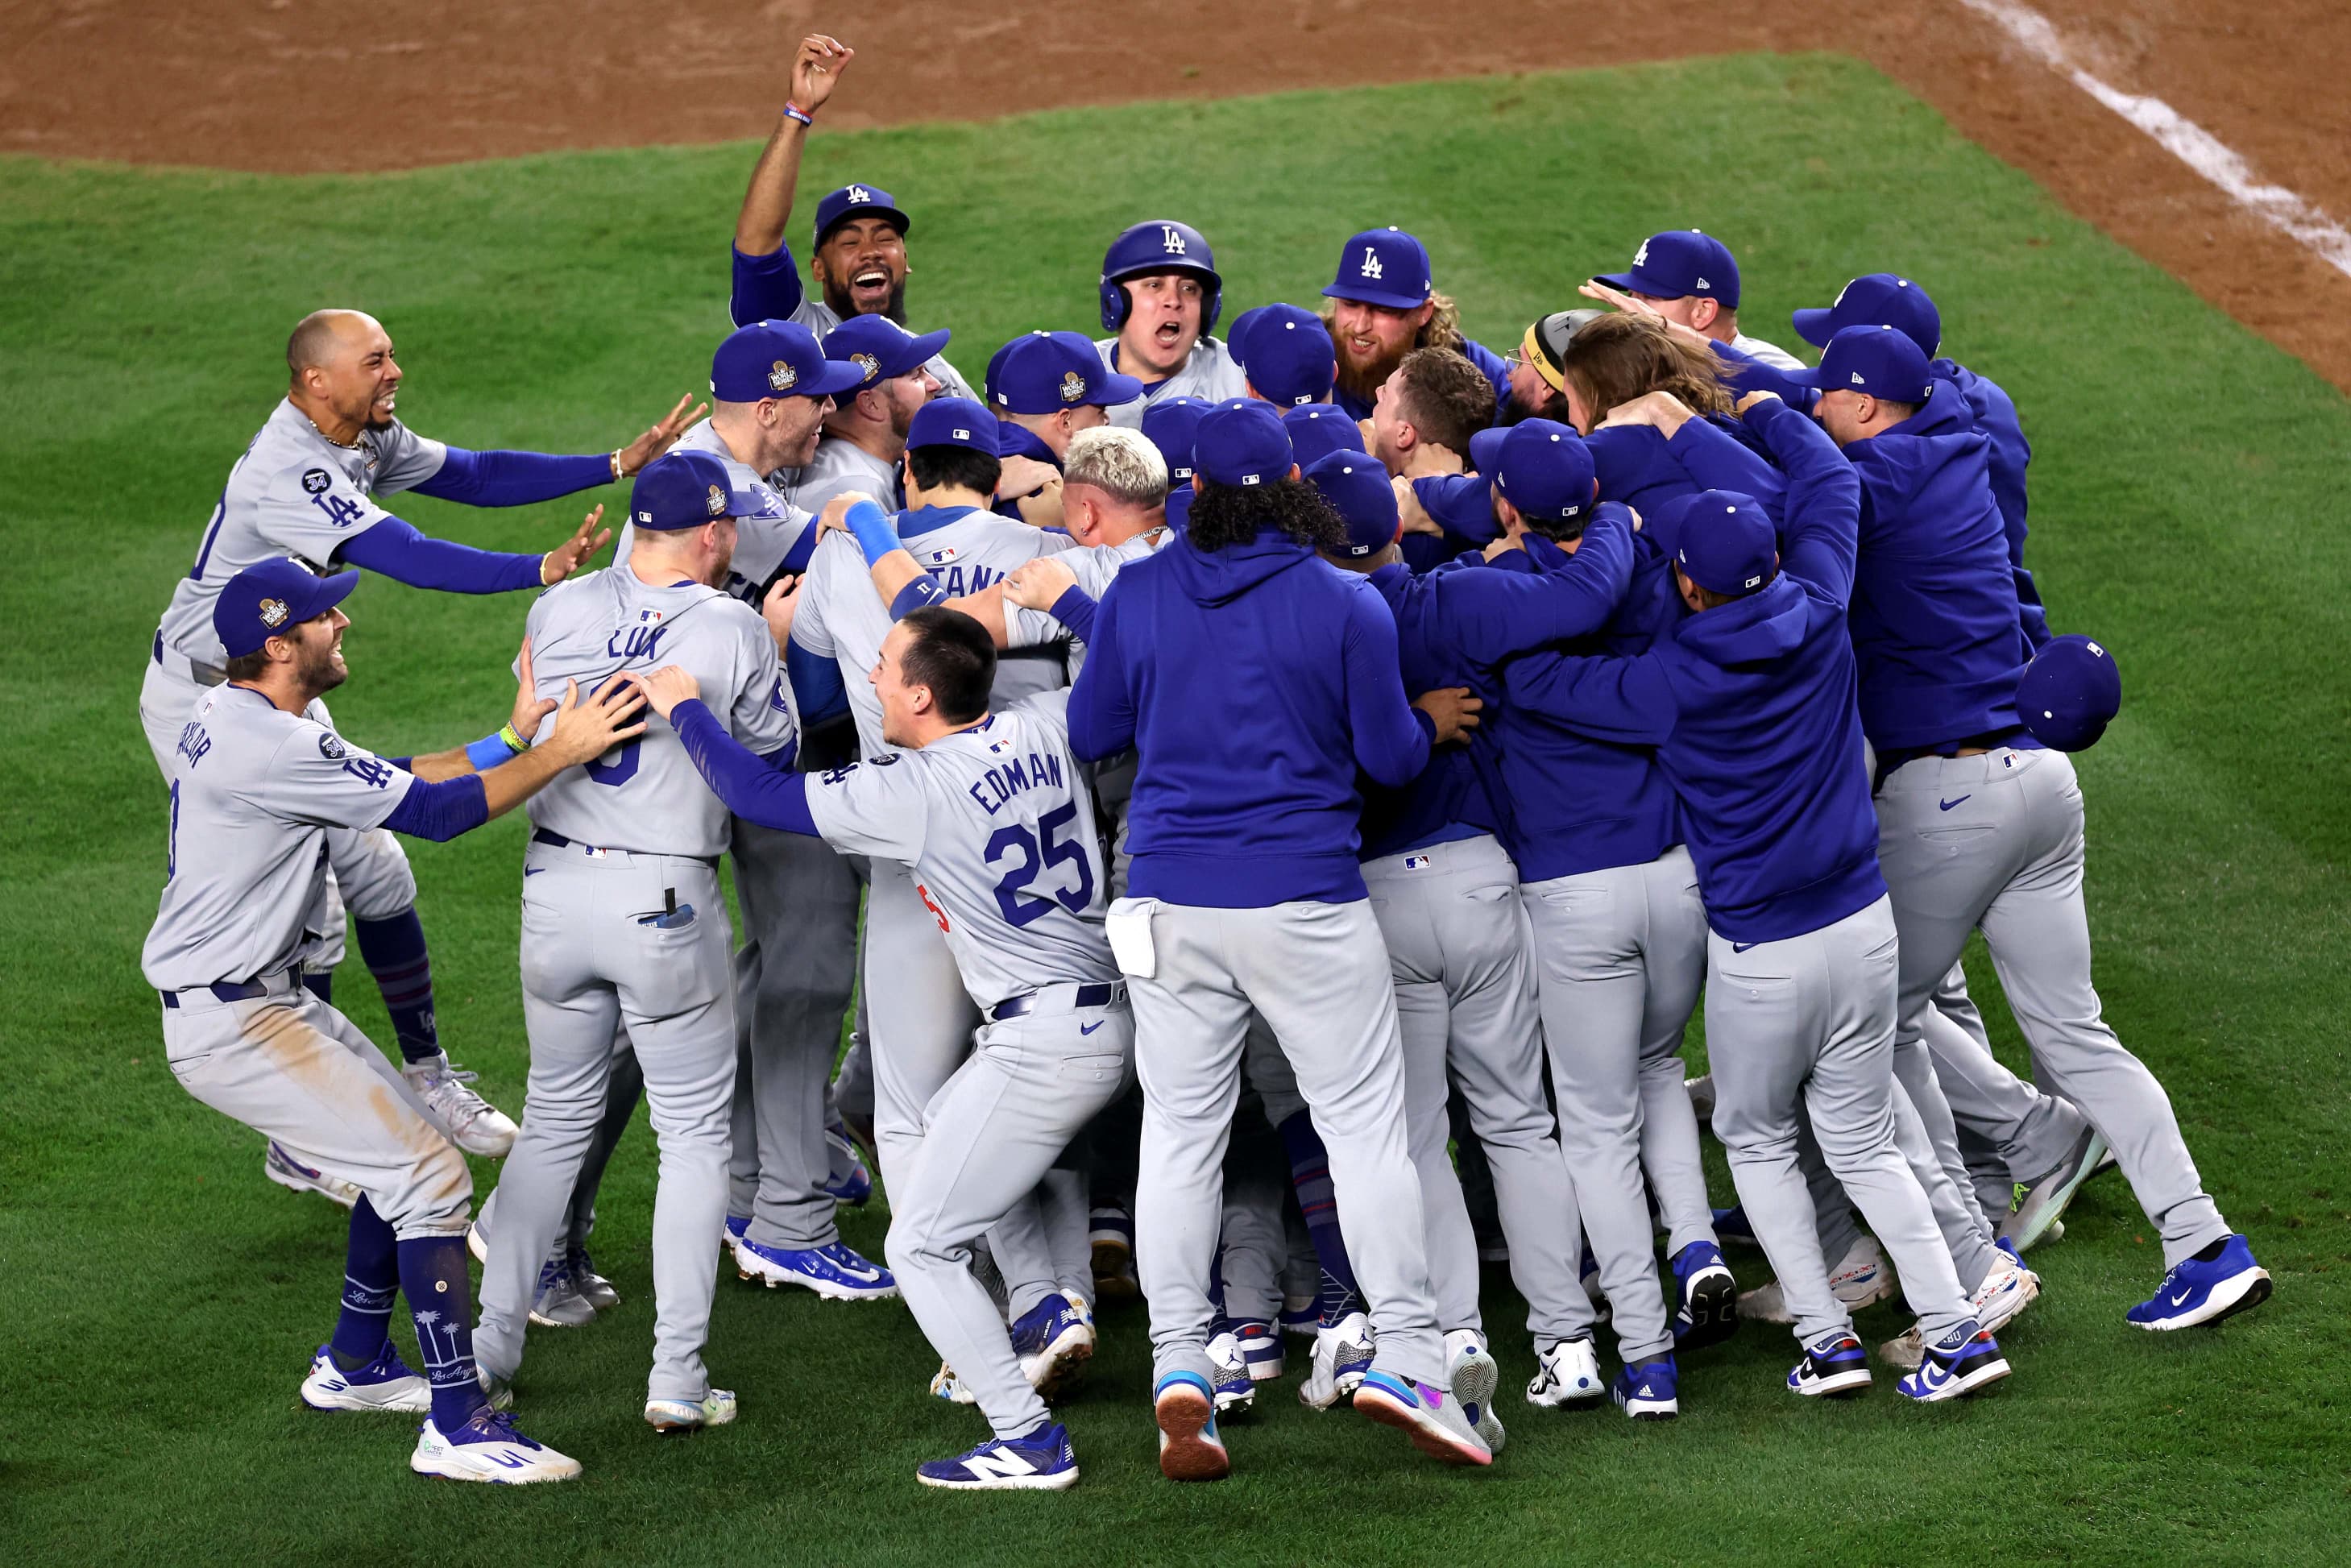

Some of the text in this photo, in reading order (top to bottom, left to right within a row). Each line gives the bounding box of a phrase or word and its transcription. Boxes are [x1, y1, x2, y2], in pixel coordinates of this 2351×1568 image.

[846, 185, 871, 204] LA
[1162, 226, 1185, 255] LA
[1361, 247, 1383, 280] LA
[307, 476, 327, 491] 34
[311, 492, 365, 527] LA
[607, 626, 668, 660] LUX
[325, 739, 343, 757] 34
[342, 758, 394, 789] LA
[969, 753, 1064, 815] EDMAN
[984, 797, 1094, 929] 25
[431, 1370, 446, 1381] Los
